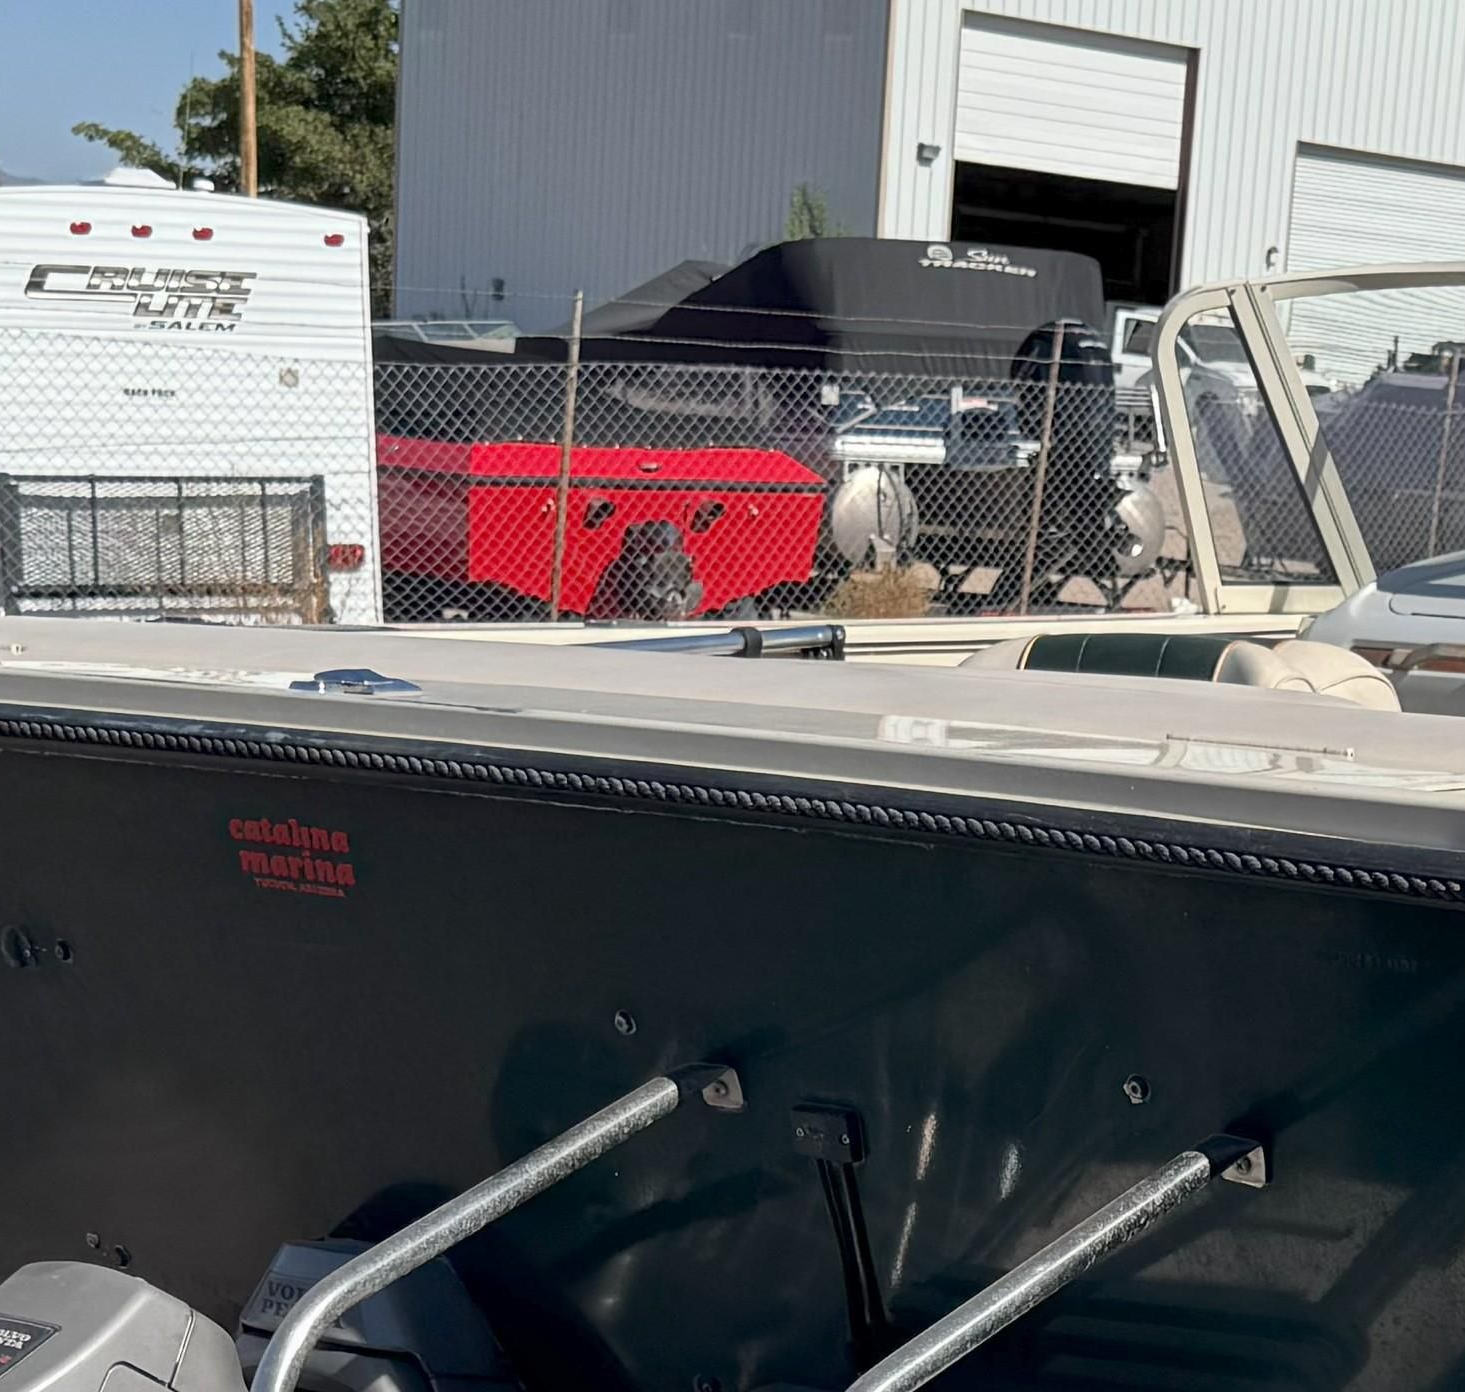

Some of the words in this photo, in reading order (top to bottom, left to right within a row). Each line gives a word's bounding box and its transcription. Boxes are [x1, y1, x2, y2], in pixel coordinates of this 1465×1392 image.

[24, 264, 258, 303] CRUISE
[133, 292, 249, 321] LITE
[148, 320, 237, 332] SALEM
[229, 818, 350, 853] catalina
[239, 849, 355, 886] marina
